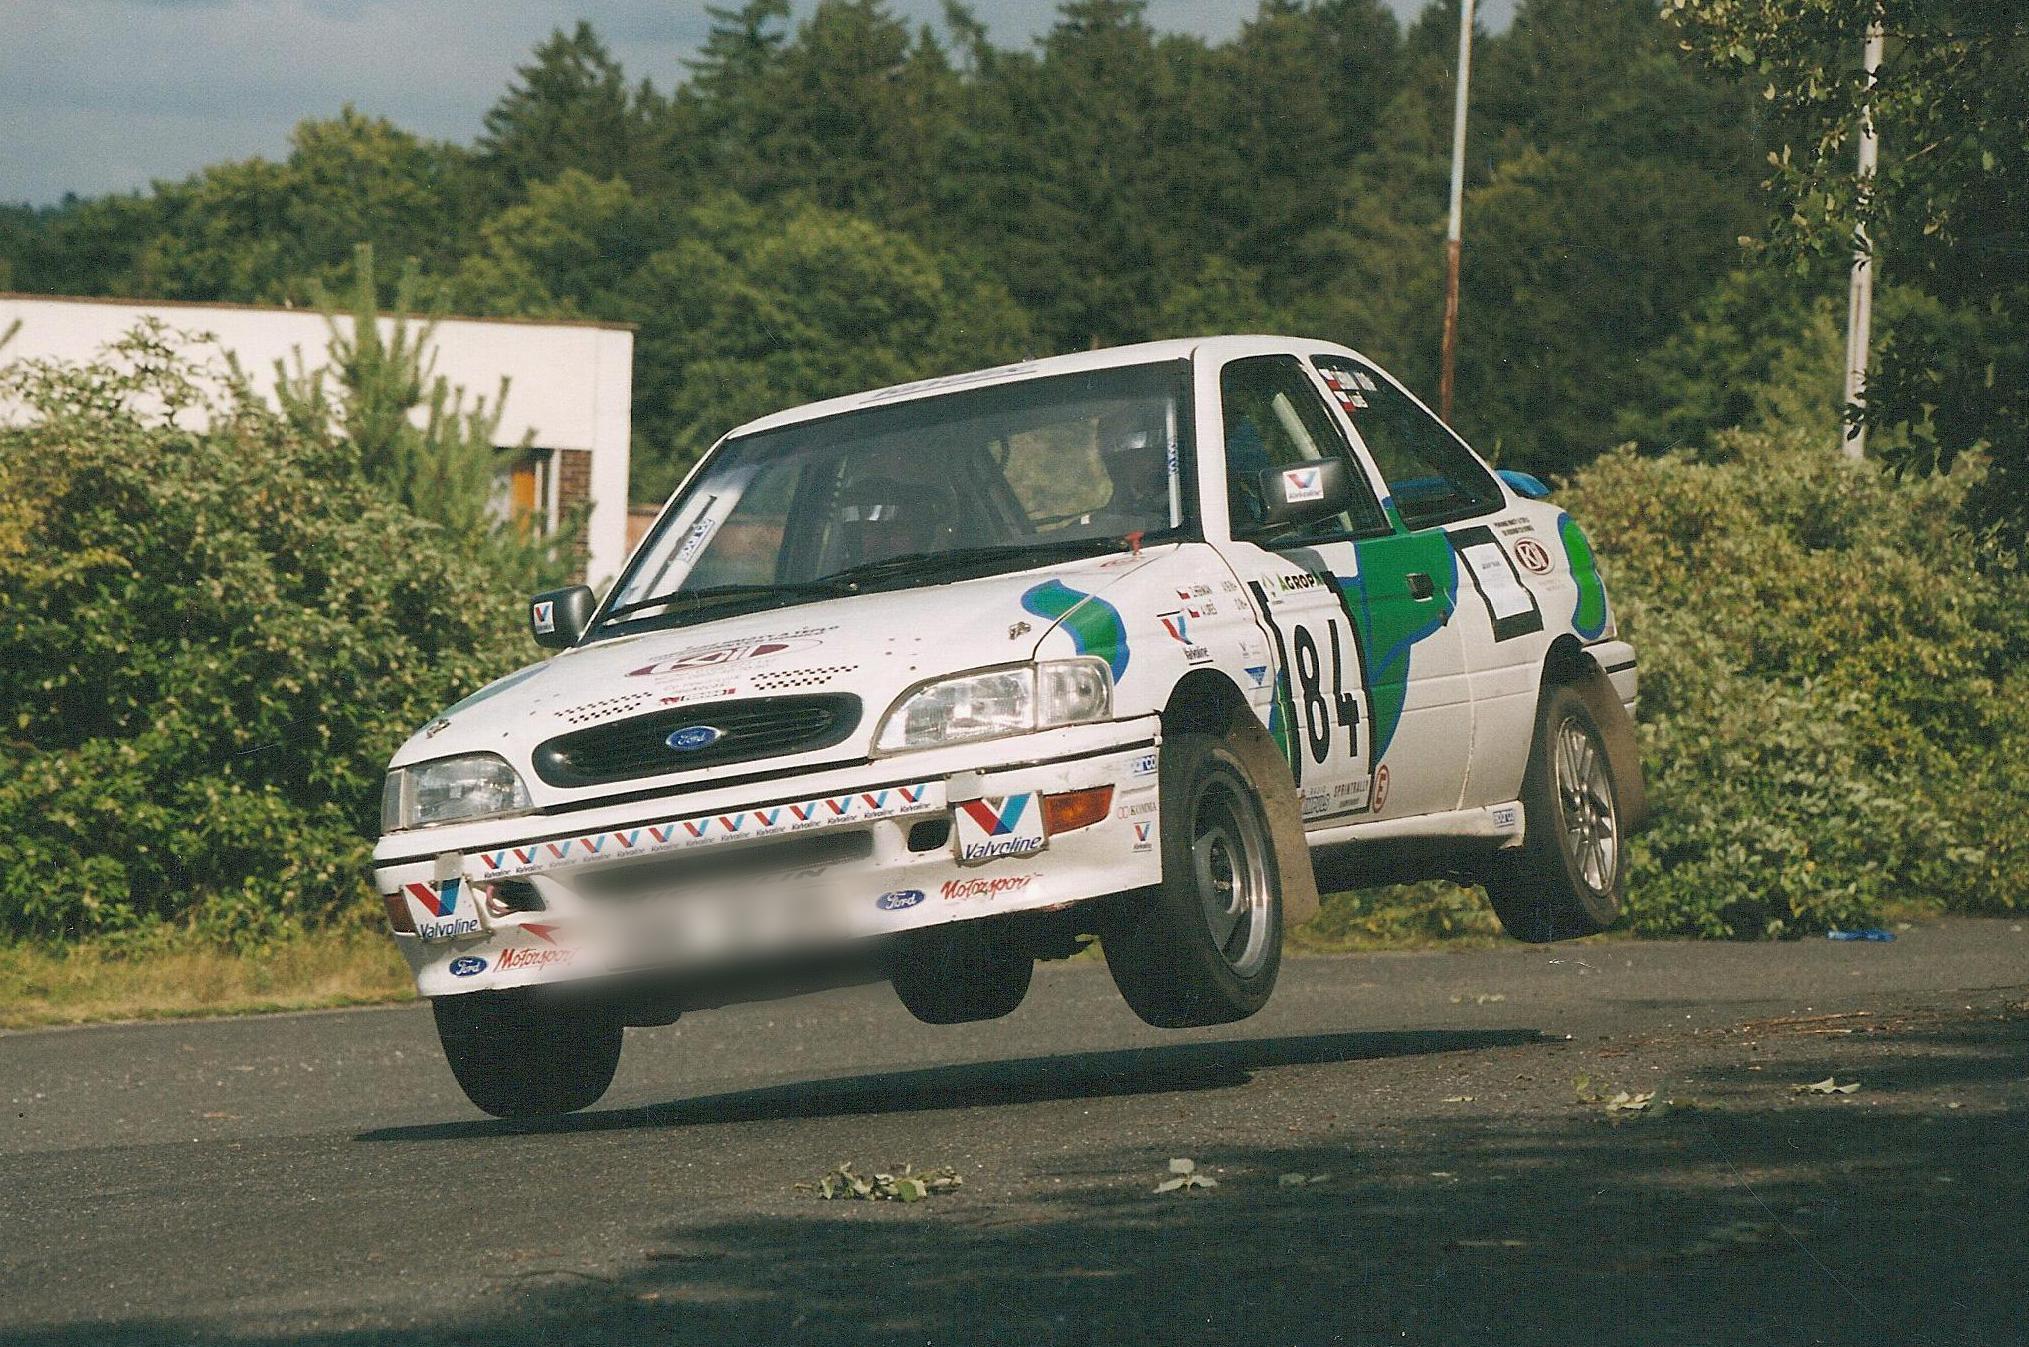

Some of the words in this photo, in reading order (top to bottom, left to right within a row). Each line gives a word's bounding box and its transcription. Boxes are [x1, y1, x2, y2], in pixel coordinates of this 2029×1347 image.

[1294, 619, 1360, 764] 84
[966, 836, 1042, 859] Valvoline
[940, 873, 1044, 901] Motorsport
[420, 918, 479, 940] Valvoline
